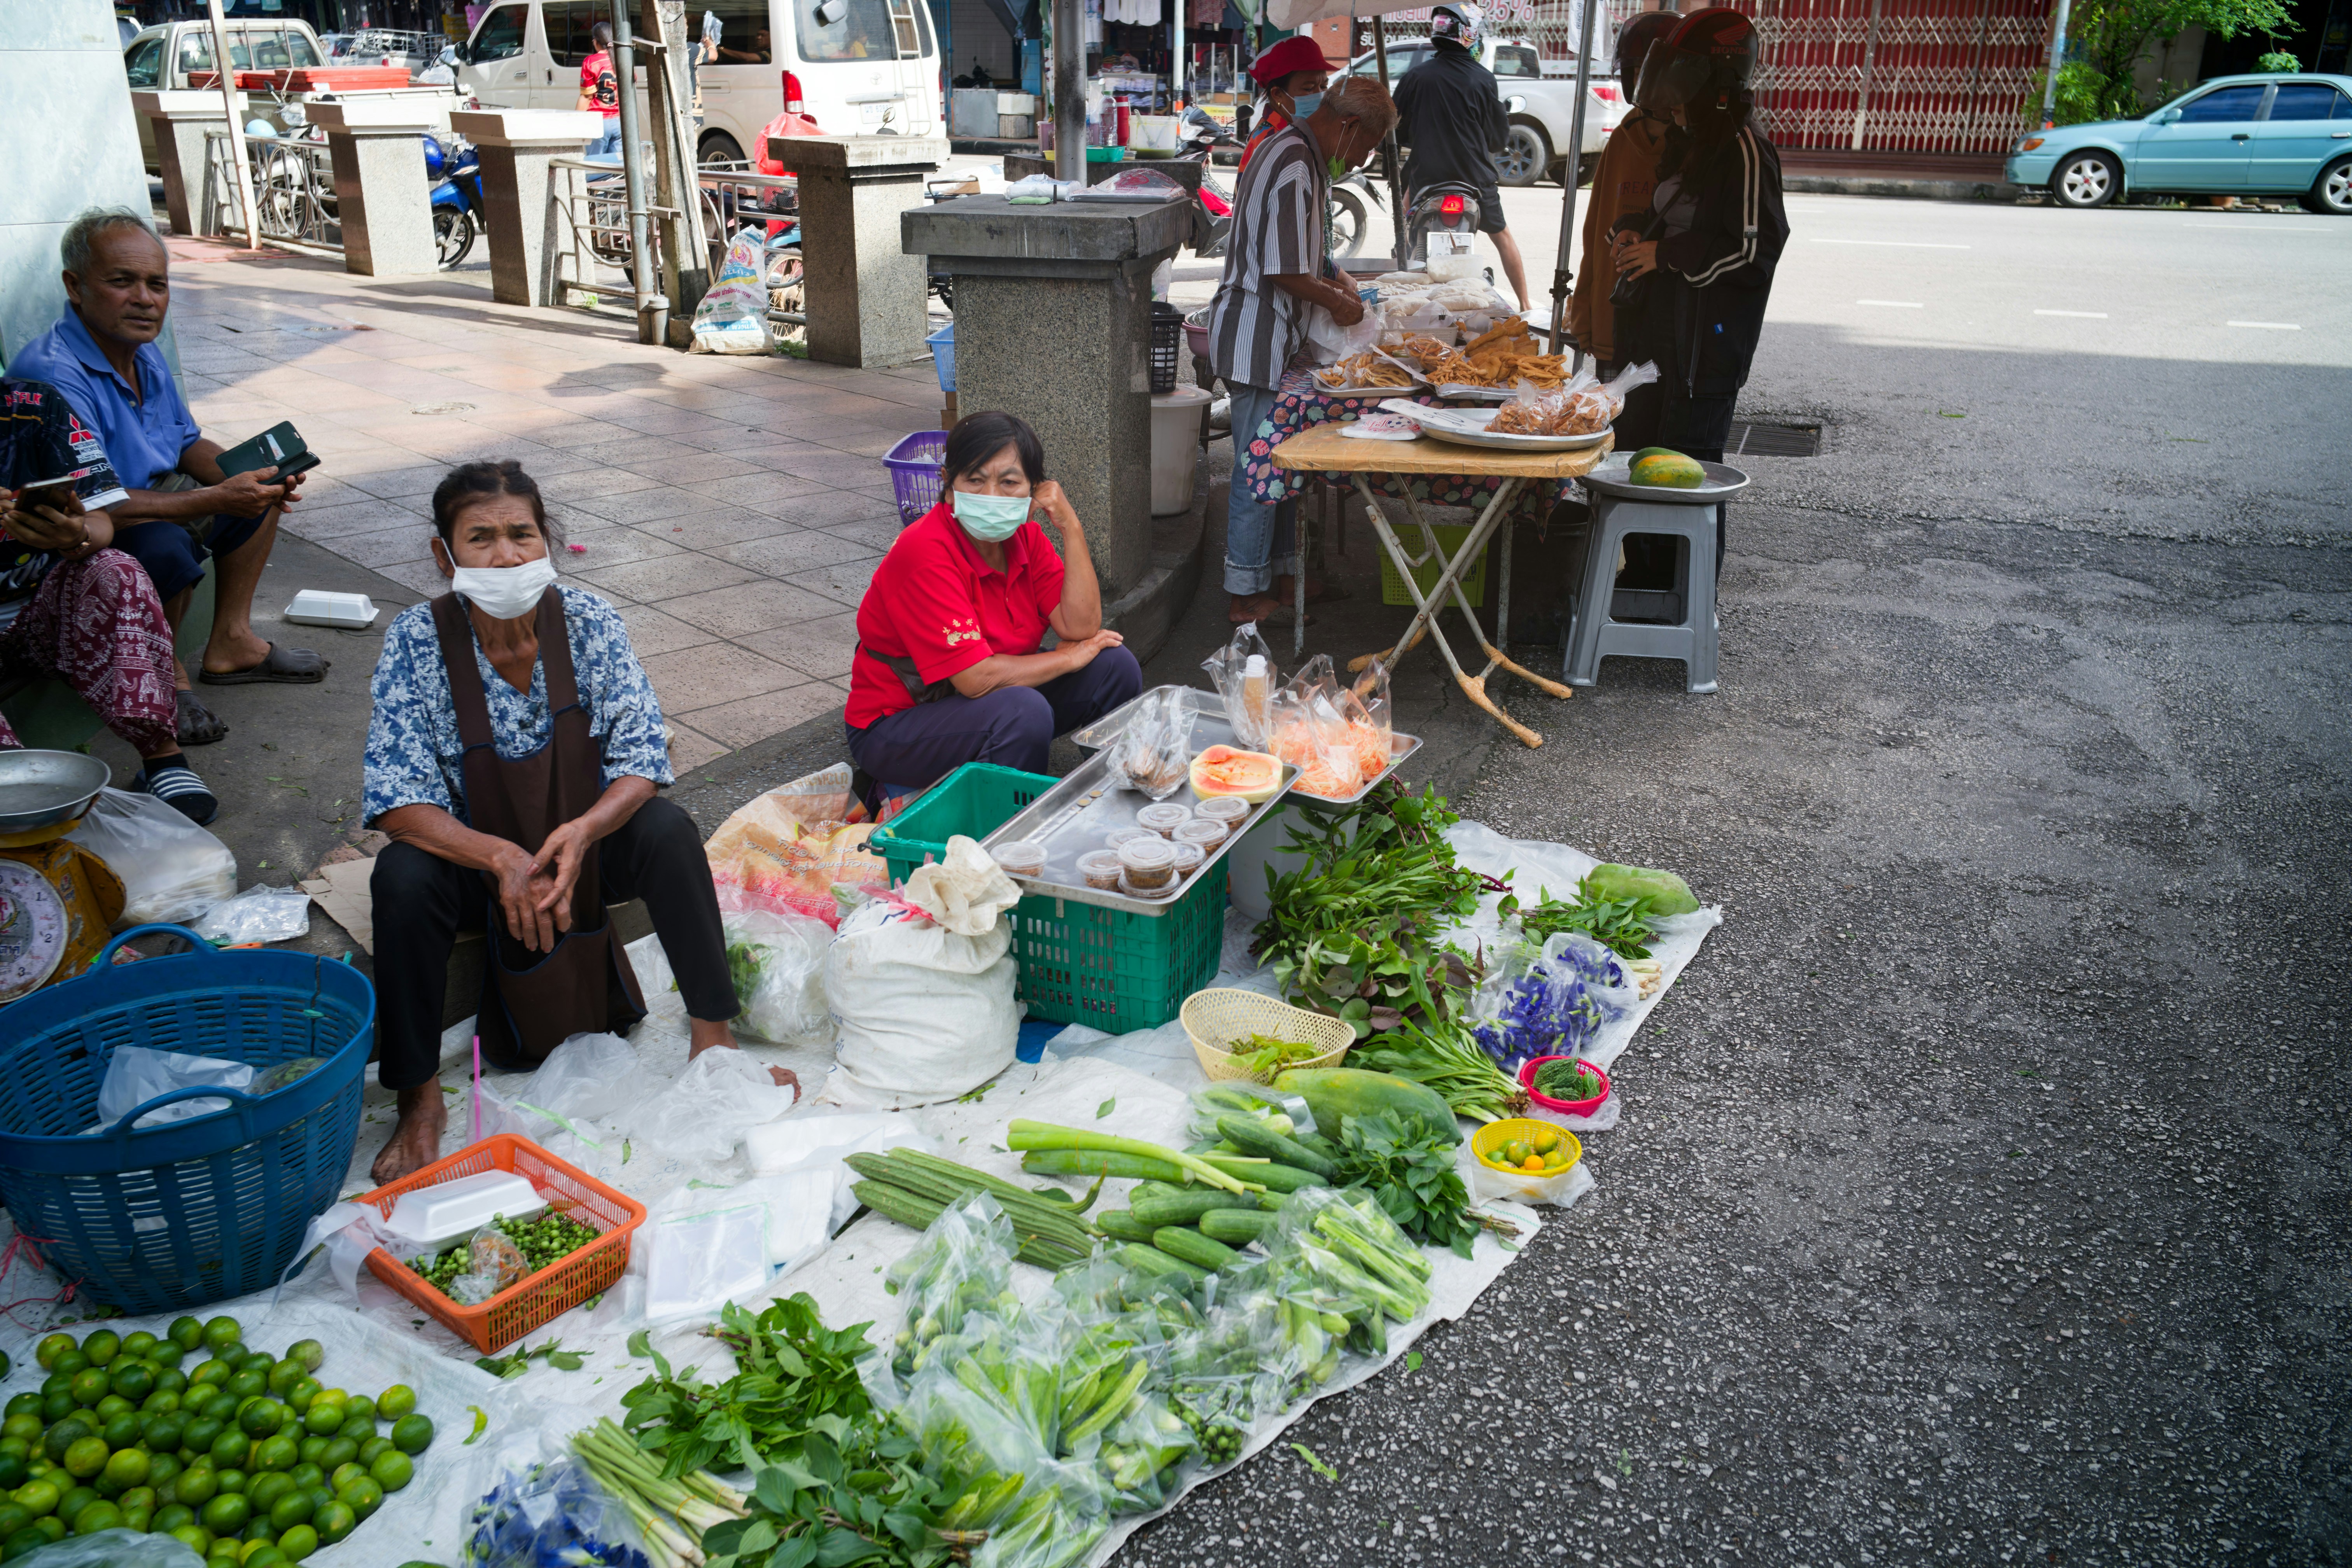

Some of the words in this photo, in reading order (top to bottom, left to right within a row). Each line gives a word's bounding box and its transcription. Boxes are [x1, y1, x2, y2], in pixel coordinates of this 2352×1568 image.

[1711, 46, 1750, 56] HONDA
[35, 892, 42, 901] 1
[44, 933, 52, 943] 2
[18, 967, 25, 976] 3
